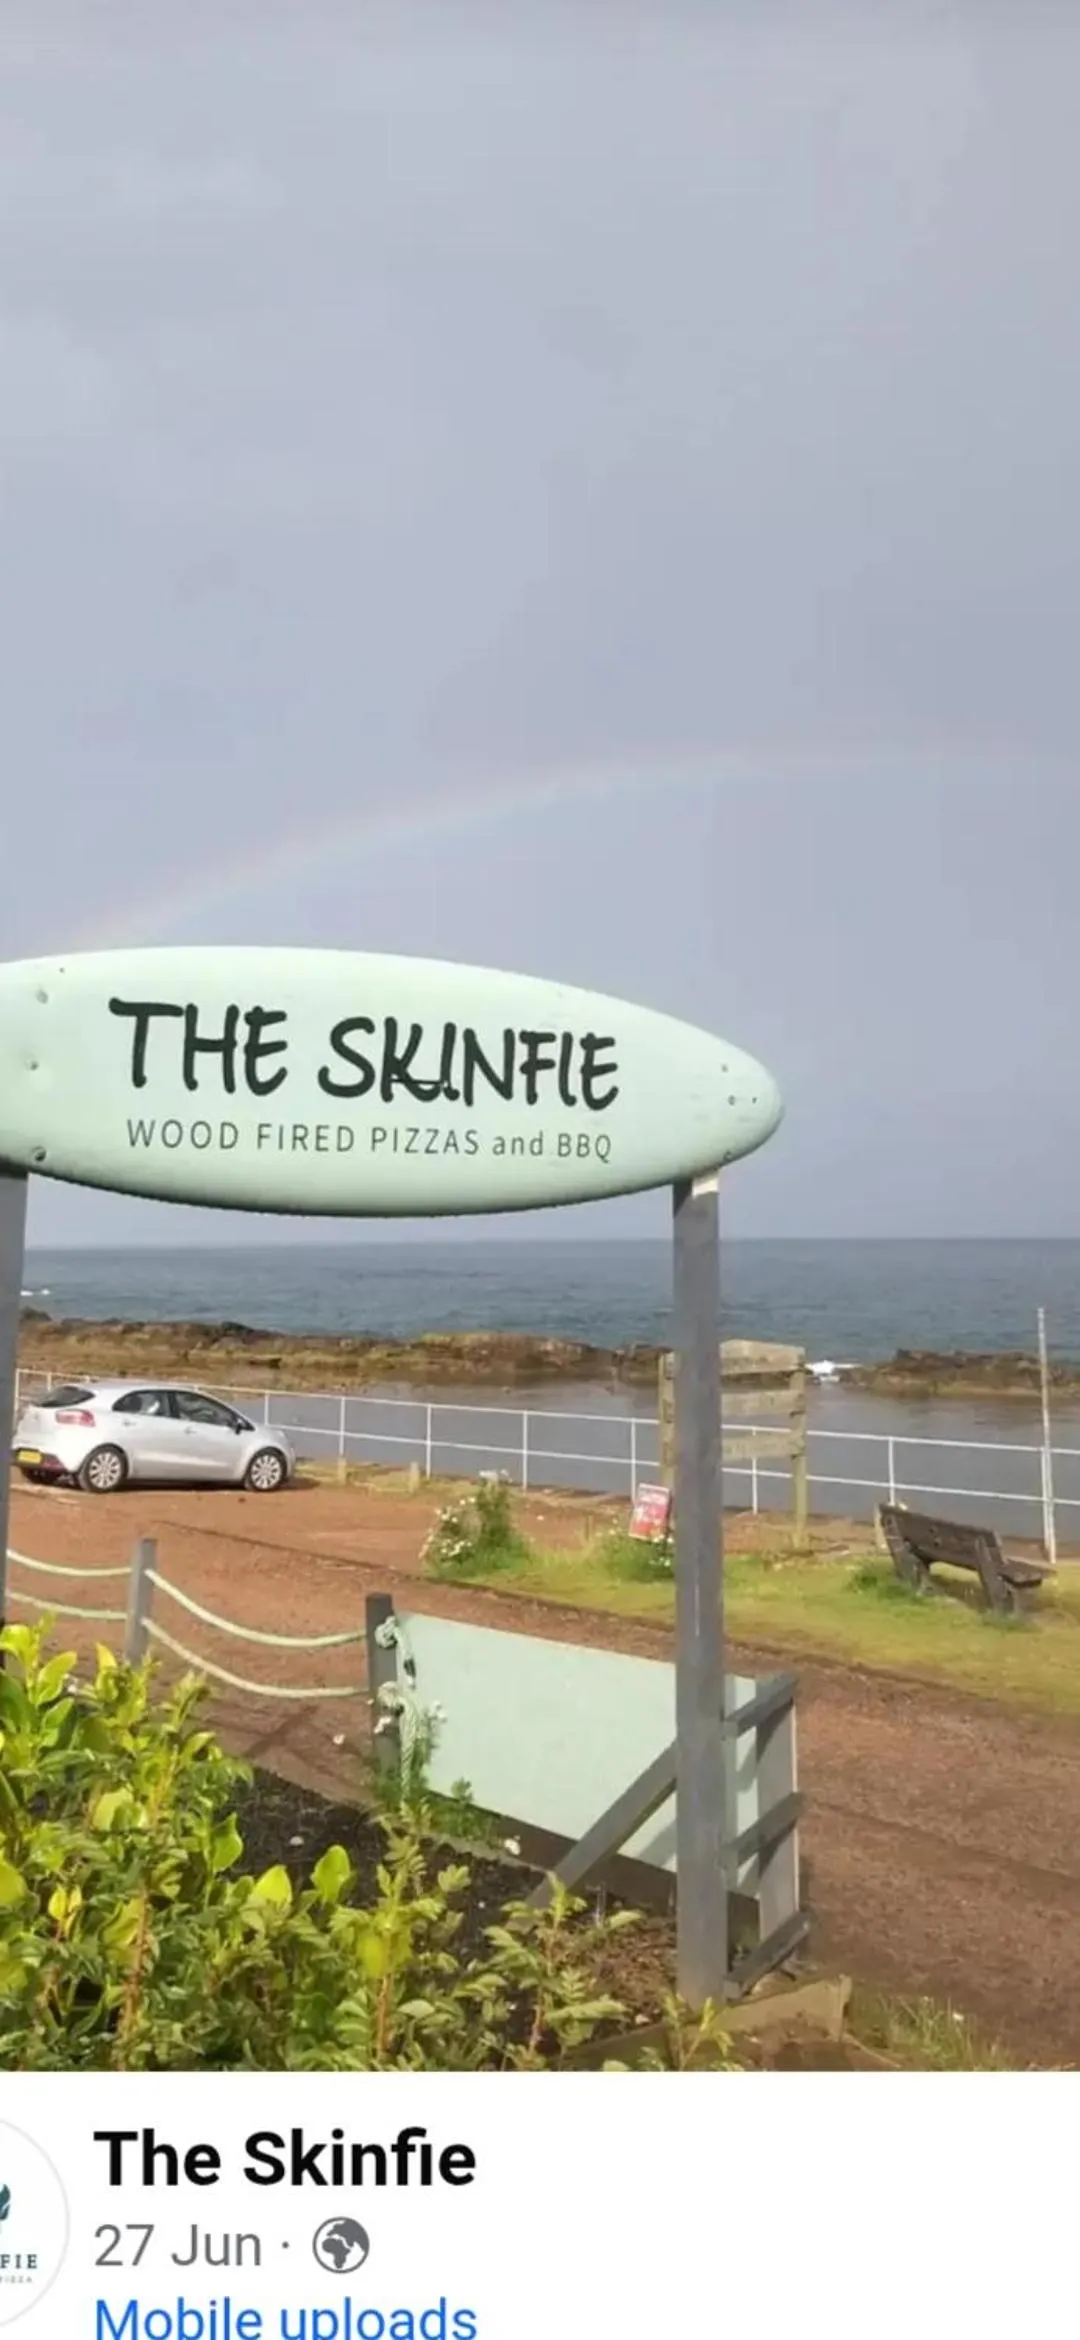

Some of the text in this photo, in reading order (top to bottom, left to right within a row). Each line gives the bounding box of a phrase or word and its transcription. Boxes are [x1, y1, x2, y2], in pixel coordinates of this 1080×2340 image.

[109, 997, 619, 1111] THE SKINFIE
[127, 1119, 612, 1163] WOOD FIRED PIZZAS and BBQ
